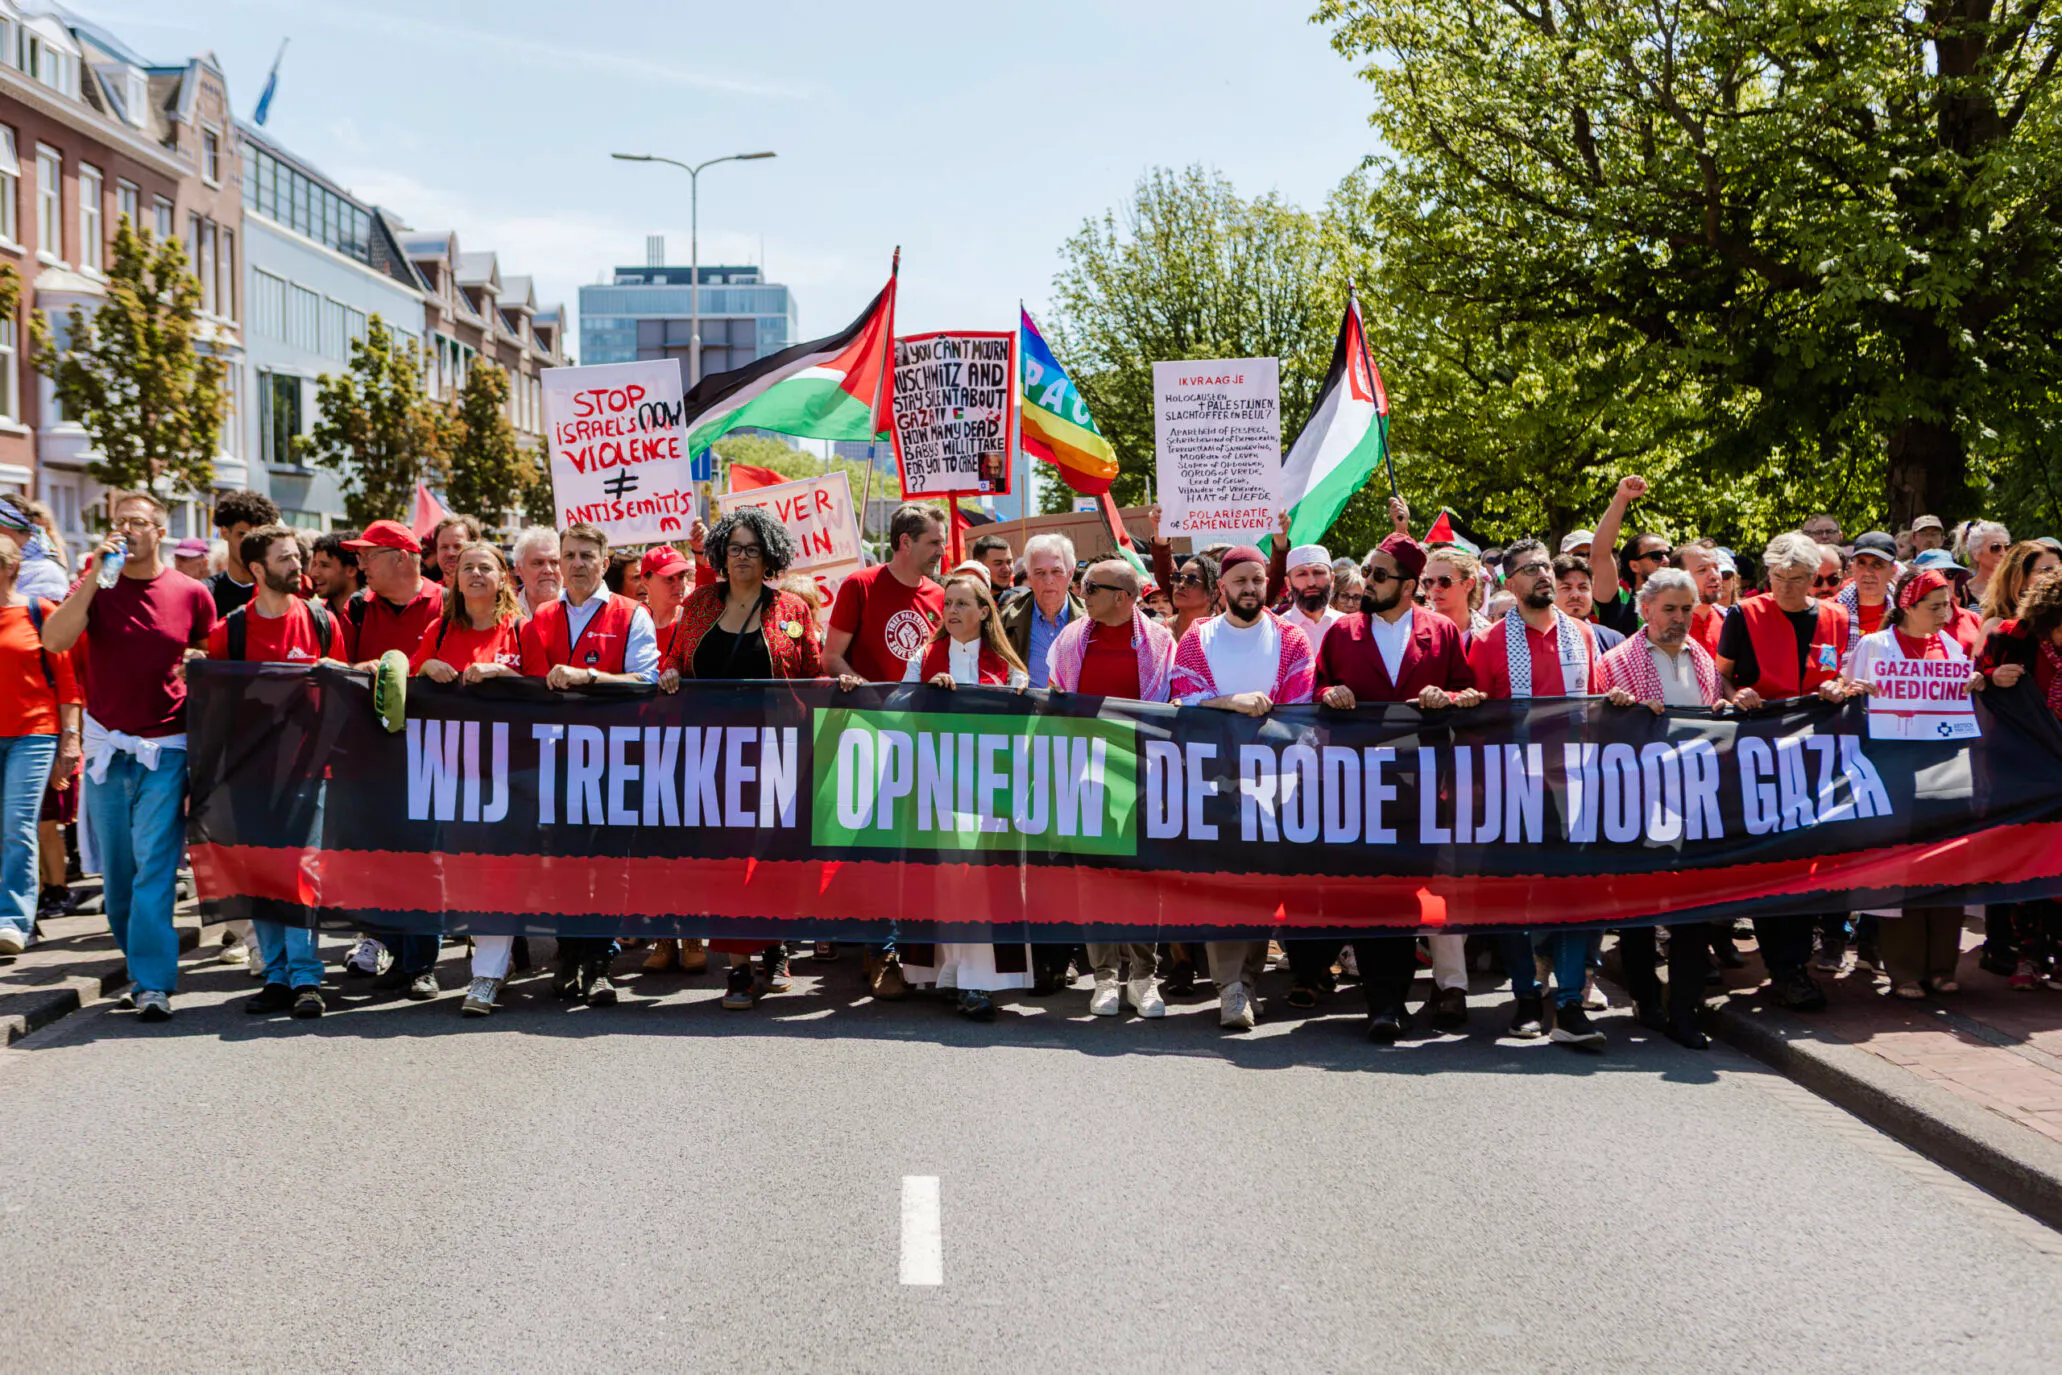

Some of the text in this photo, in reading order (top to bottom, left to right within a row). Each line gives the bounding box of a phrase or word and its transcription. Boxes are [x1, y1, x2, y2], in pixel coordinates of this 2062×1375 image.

[910, 344, 931, 364] YOU
[972, 340, 1008, 360] MOURN
[968, 363, 1004, 387] AND
[1190, 376, 1230, 386] VRAAG
[1232, 375, 1244, 384] JE
[573, 385, 645, 417] STOP
[893, 392, 923, 412] STAY
[961, 387, 1007, 410] ABOUT
[1025, 359, 1100, 435] PAC
[1165, 410, 1229, 421] SLACHTOFFER
[901, 419, 999, 446] HOW MANY DEAD
[1219, 426, 1228, 435] of
[561, 437, 682, 474] VIOLENCE
[904, 442, 939, 460] BABYS
[906, 459, 925, 475] FOR
[942, 456, 957, 472] TO
[959, 454, 978, 472] CARE
[1181, 469, 1217, 478] OORLOG
[1219, 468, 1228, 476] of
[1186, 493, 1216, 503] HAAT
[1218, 493, 1229, 501] of
[1874, 661, 1970, 678] GAZA NEEDS
[1874, 680, 1968, 701] MEDICINE
[406, 718, 1893, 844] WIJ TREKKEN OPNIEUW DE RODE LIJN VOOR GAZA
